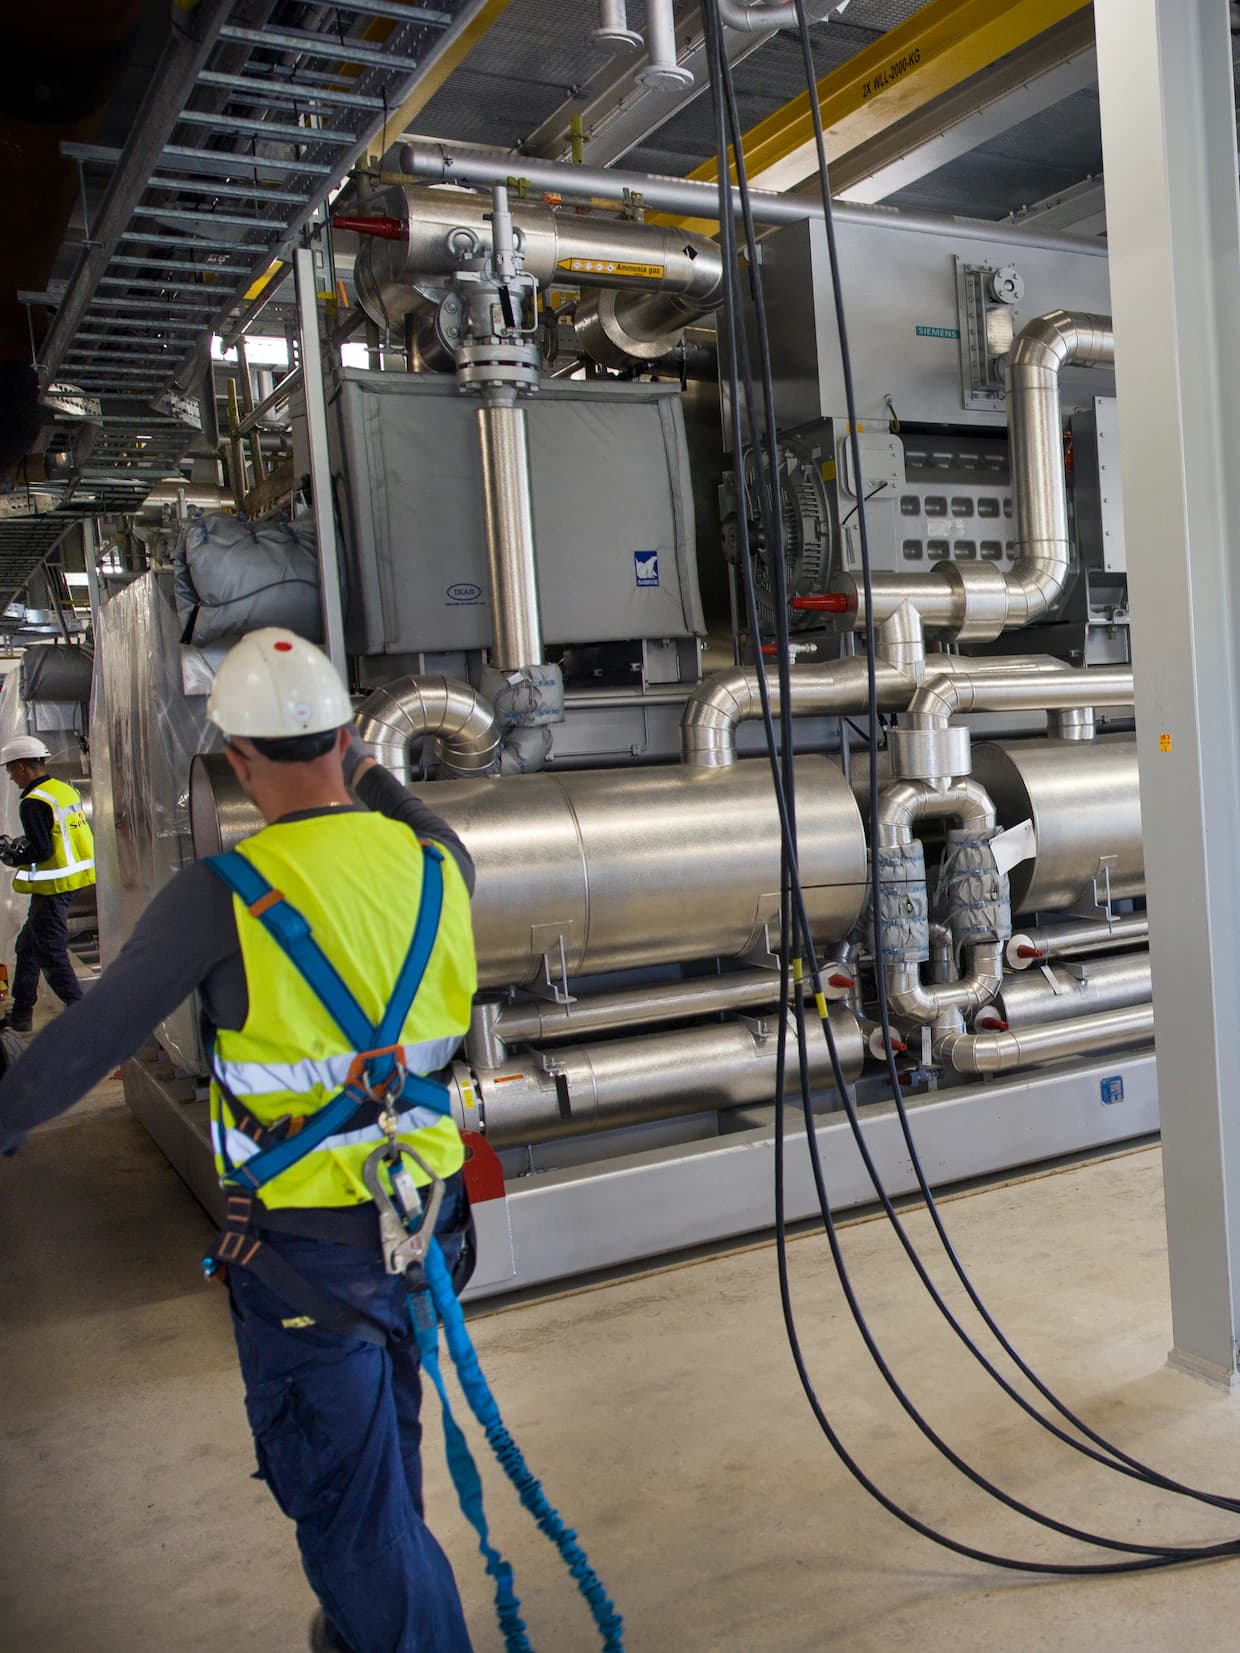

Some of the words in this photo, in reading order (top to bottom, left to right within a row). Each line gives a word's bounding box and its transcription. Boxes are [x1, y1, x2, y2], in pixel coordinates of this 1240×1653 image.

[863, 80, 872, 98] 2X
[874, 48, 921, 91] WLL-2000-KG
[616, 263, 648, 273] Ammonia
[648, 267, 660, 275] gas
[918, 327, 957, 338] SIEMENS
